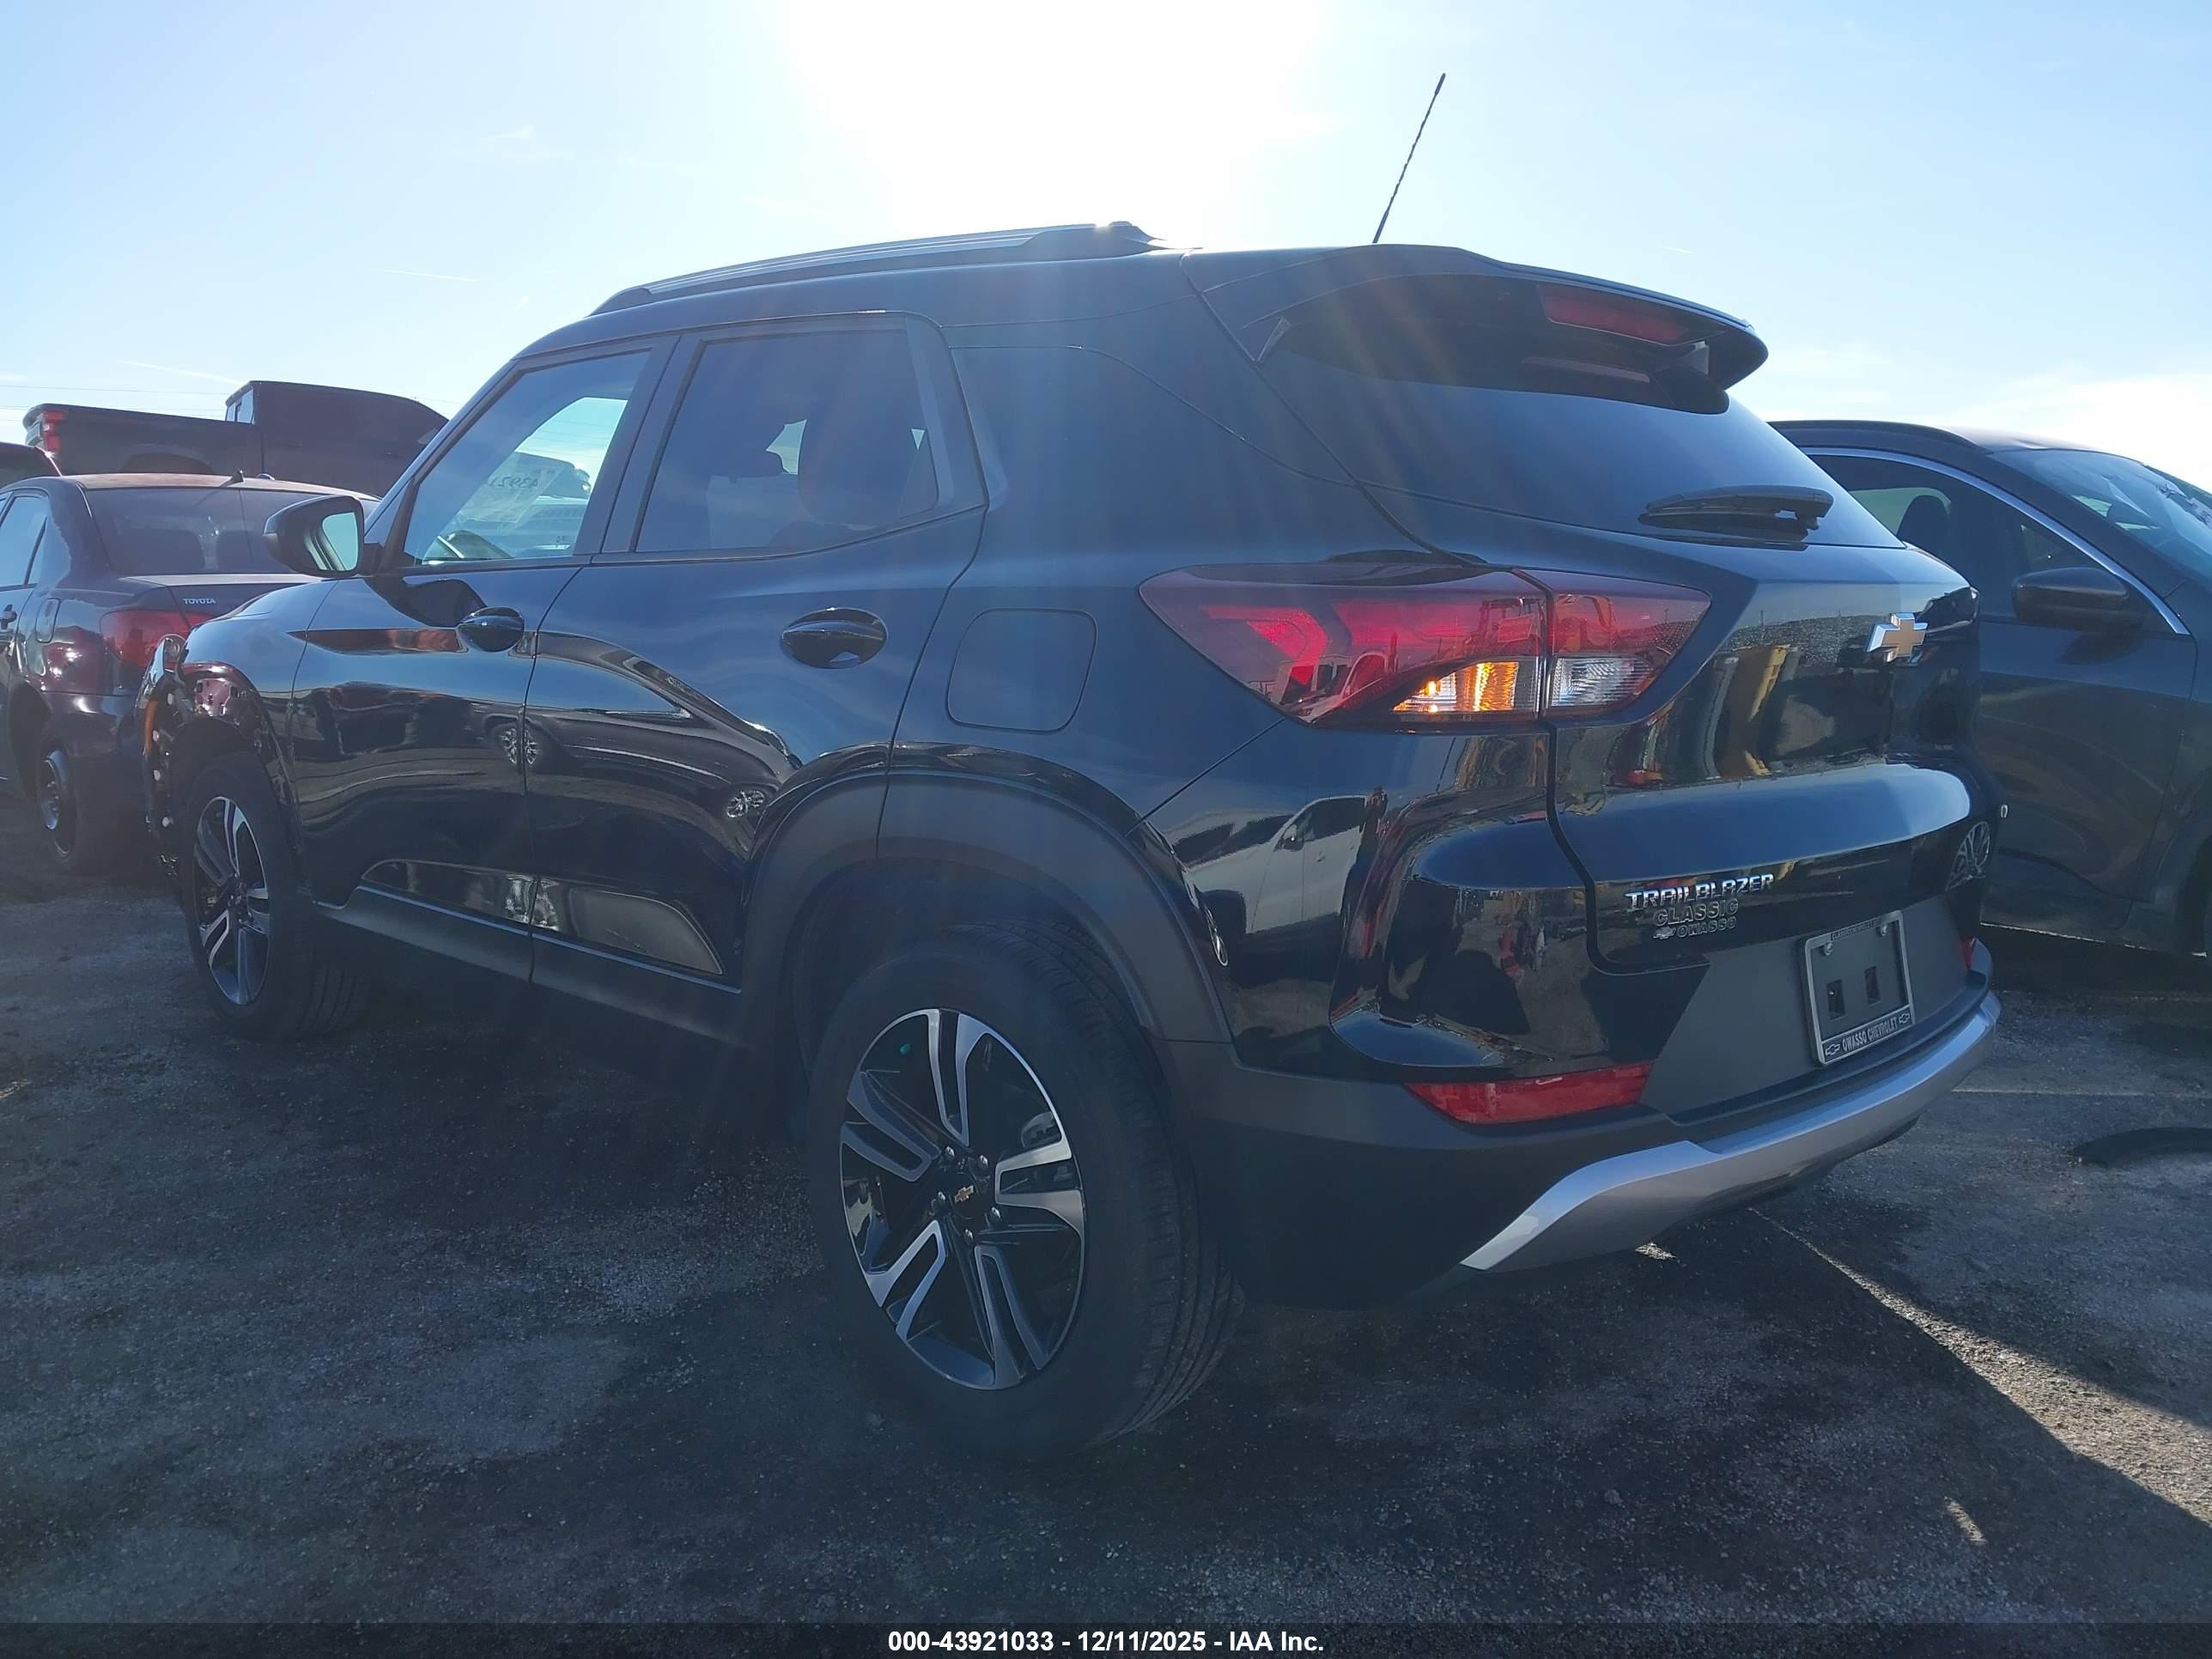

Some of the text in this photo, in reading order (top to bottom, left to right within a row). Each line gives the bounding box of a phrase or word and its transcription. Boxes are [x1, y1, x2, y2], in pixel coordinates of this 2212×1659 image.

[1625, 873, 1775, 911] TRAILBLAZER
[1652, 898, 1739, 927] CLASSIC
[1677, 916, 1737, 938] OWASSO
[1842, 1017, 1898, 1052] OWASSO CHEVROLET
